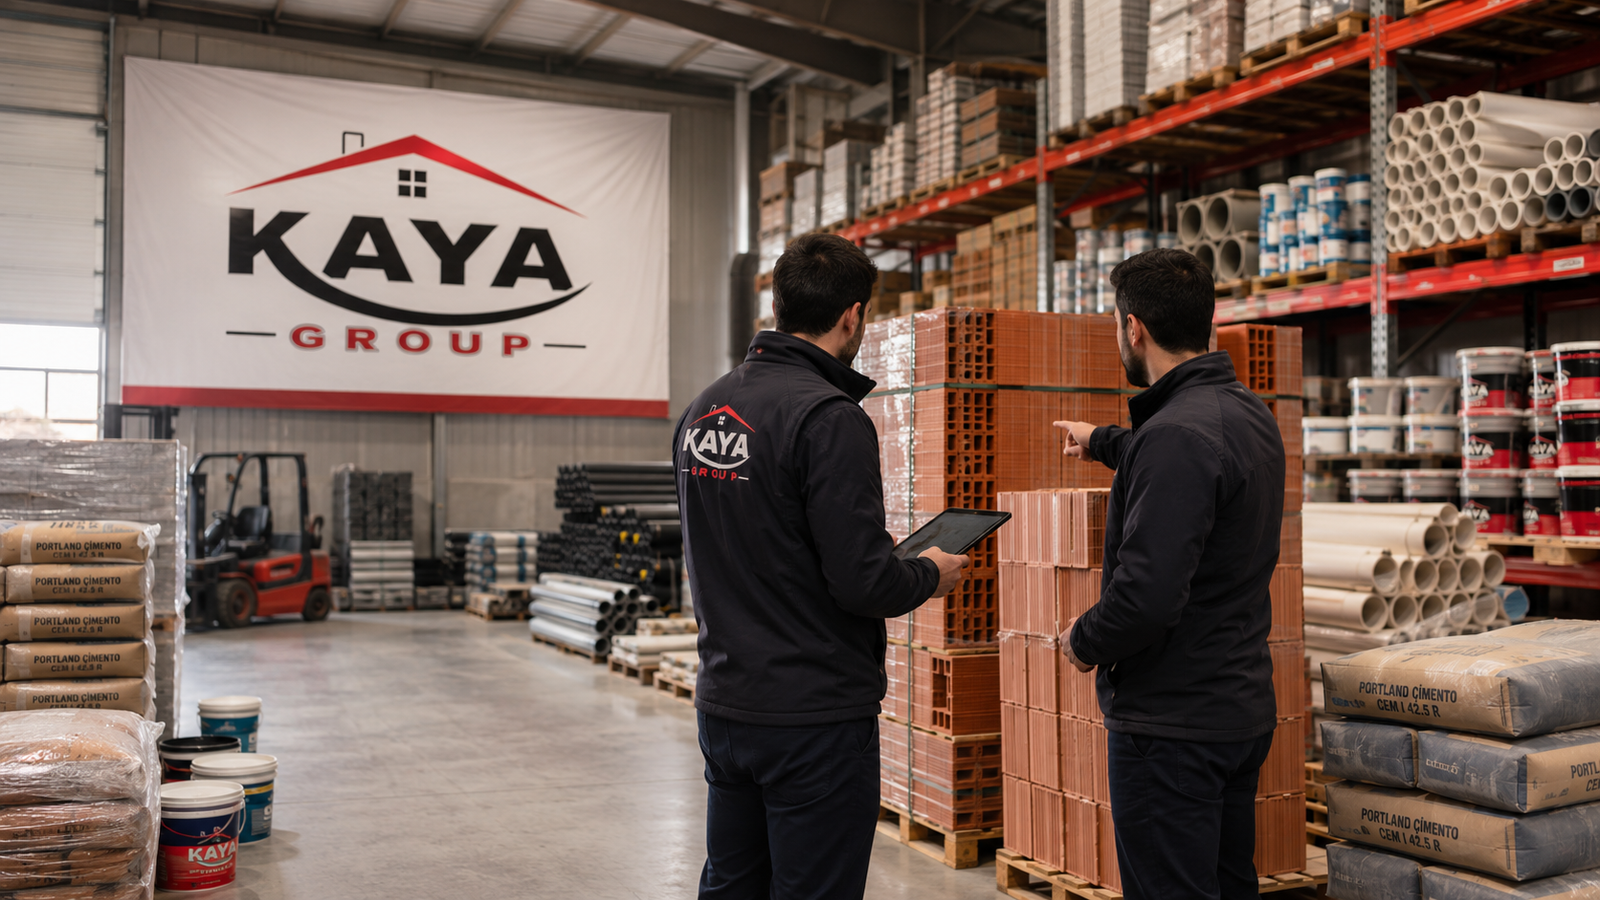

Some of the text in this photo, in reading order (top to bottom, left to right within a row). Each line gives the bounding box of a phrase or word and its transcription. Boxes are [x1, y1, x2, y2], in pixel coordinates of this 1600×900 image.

[228, 206, 578, 304] KAYA
[289, 323, 532, 358] GROUP
[682, 427, 750, 463] KAYA
[691, 466, 738, 481] GROUP
[36, 542, 81, 551] PORTLAND
[35, 577, 81, 586] PORTLAND
[34, 616, 81, 626] PORTLAND
[33, 655, 81, 664] PORTLAND
[32, 694, 79, 704] PORTLAND
[1359, 681, 1458, 703] PORTLAND ÇİMENTO
[1376, 698, 1399, 712] CEM
[1400, 701, 1405, 713] I
[1407, 702, 1430, 717] 42.5
[1432, 704, 1441, 718] R
[1361, 807, 1459, 840] PORTLAND ÇİMENTO
[1379, 827, 1401, 843] CEM
[1402, 832, 1407, 844] I
[1409, 834, 1431, 850] 42.5
[1433, 839, 1442, 852] R
[188, 841, 236, 864] KAYA
